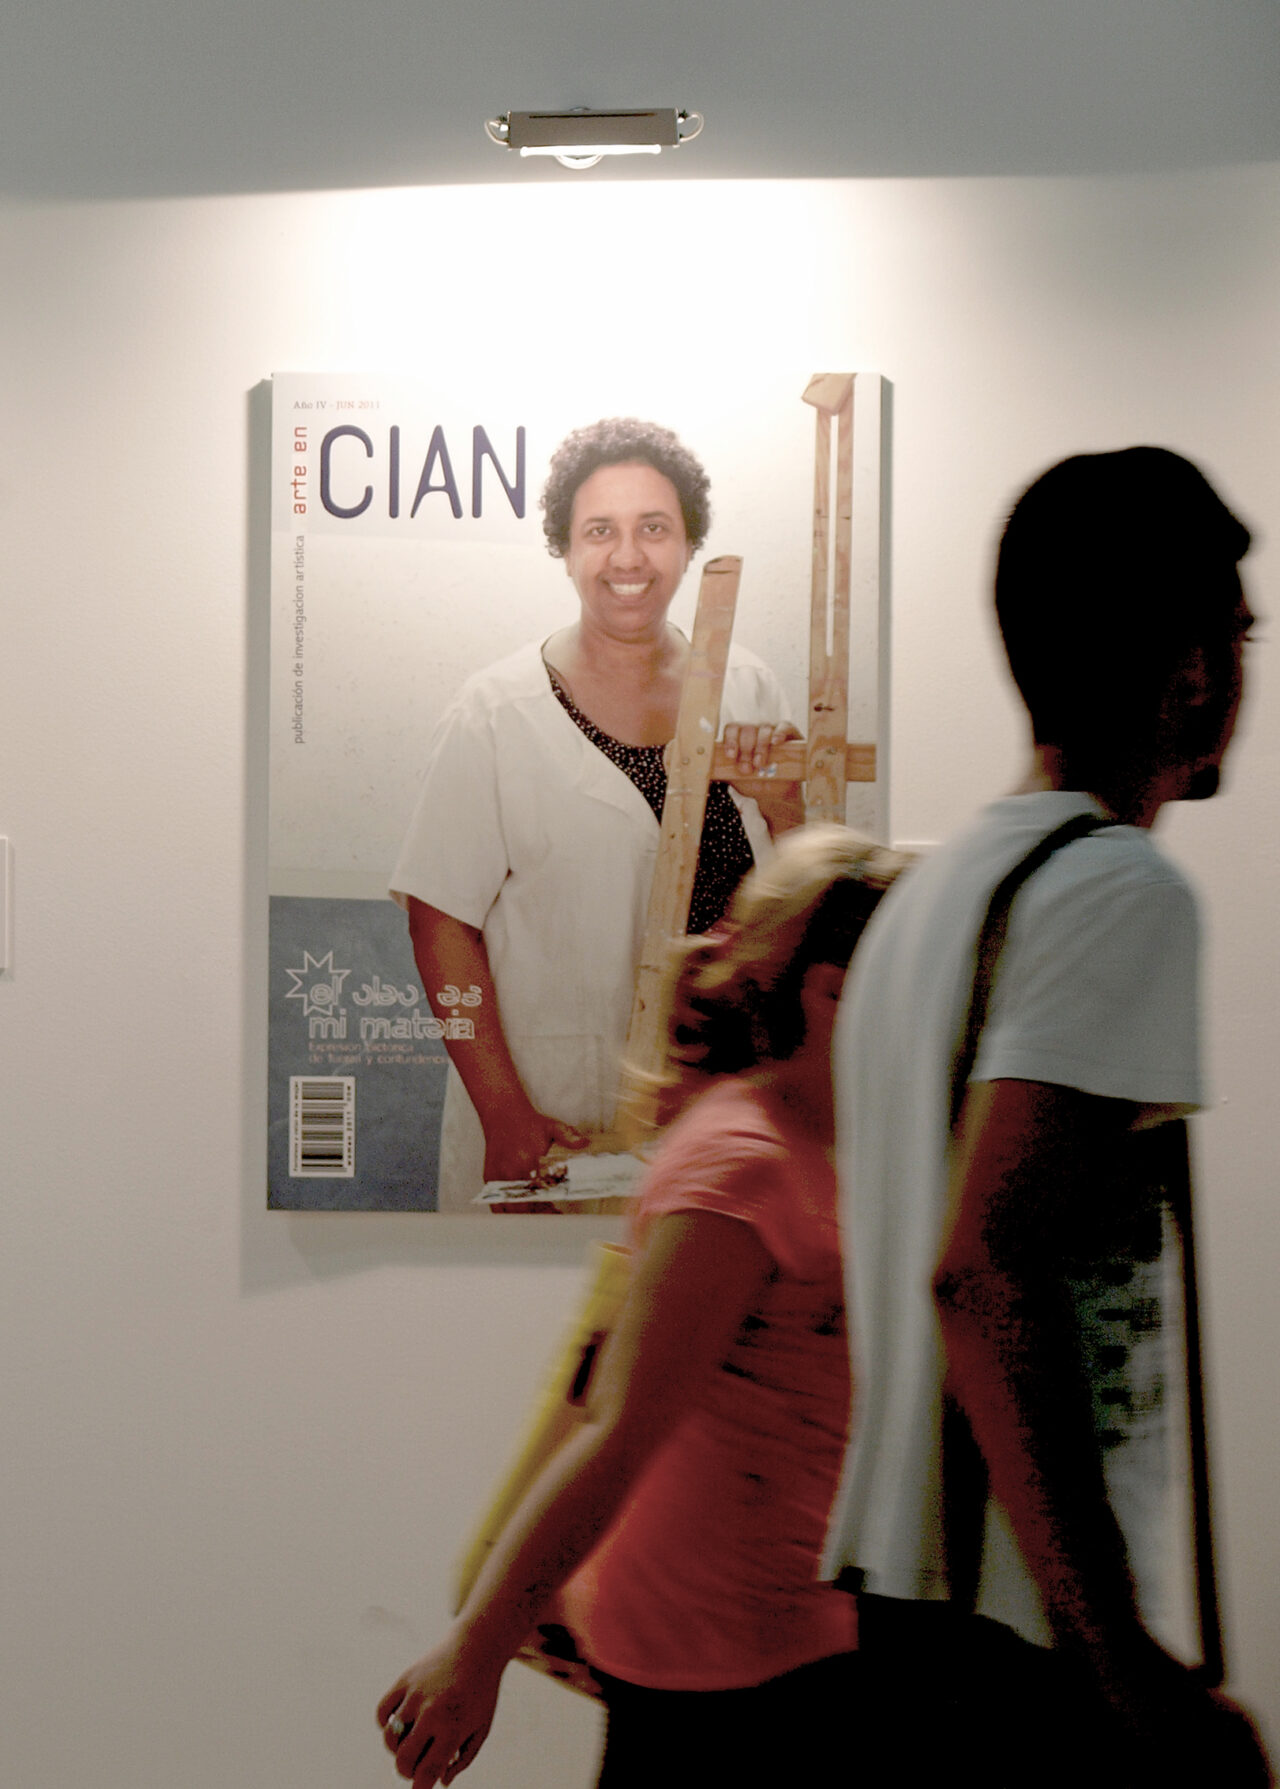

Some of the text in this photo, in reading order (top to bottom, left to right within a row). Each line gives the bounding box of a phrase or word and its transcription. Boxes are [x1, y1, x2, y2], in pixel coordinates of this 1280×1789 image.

[316, 401, 327, 409] IV
[336, 400, 354, 410] JUN
[358, 400, 380, 409] 2011
[290, 426, 307, 515] arte en
[320, 424, 526, 519] CIAN
[292, 662, 304, 677] de
[291, 680, 305, 745] publicación
[309, 1008, 347, 1039] mi
